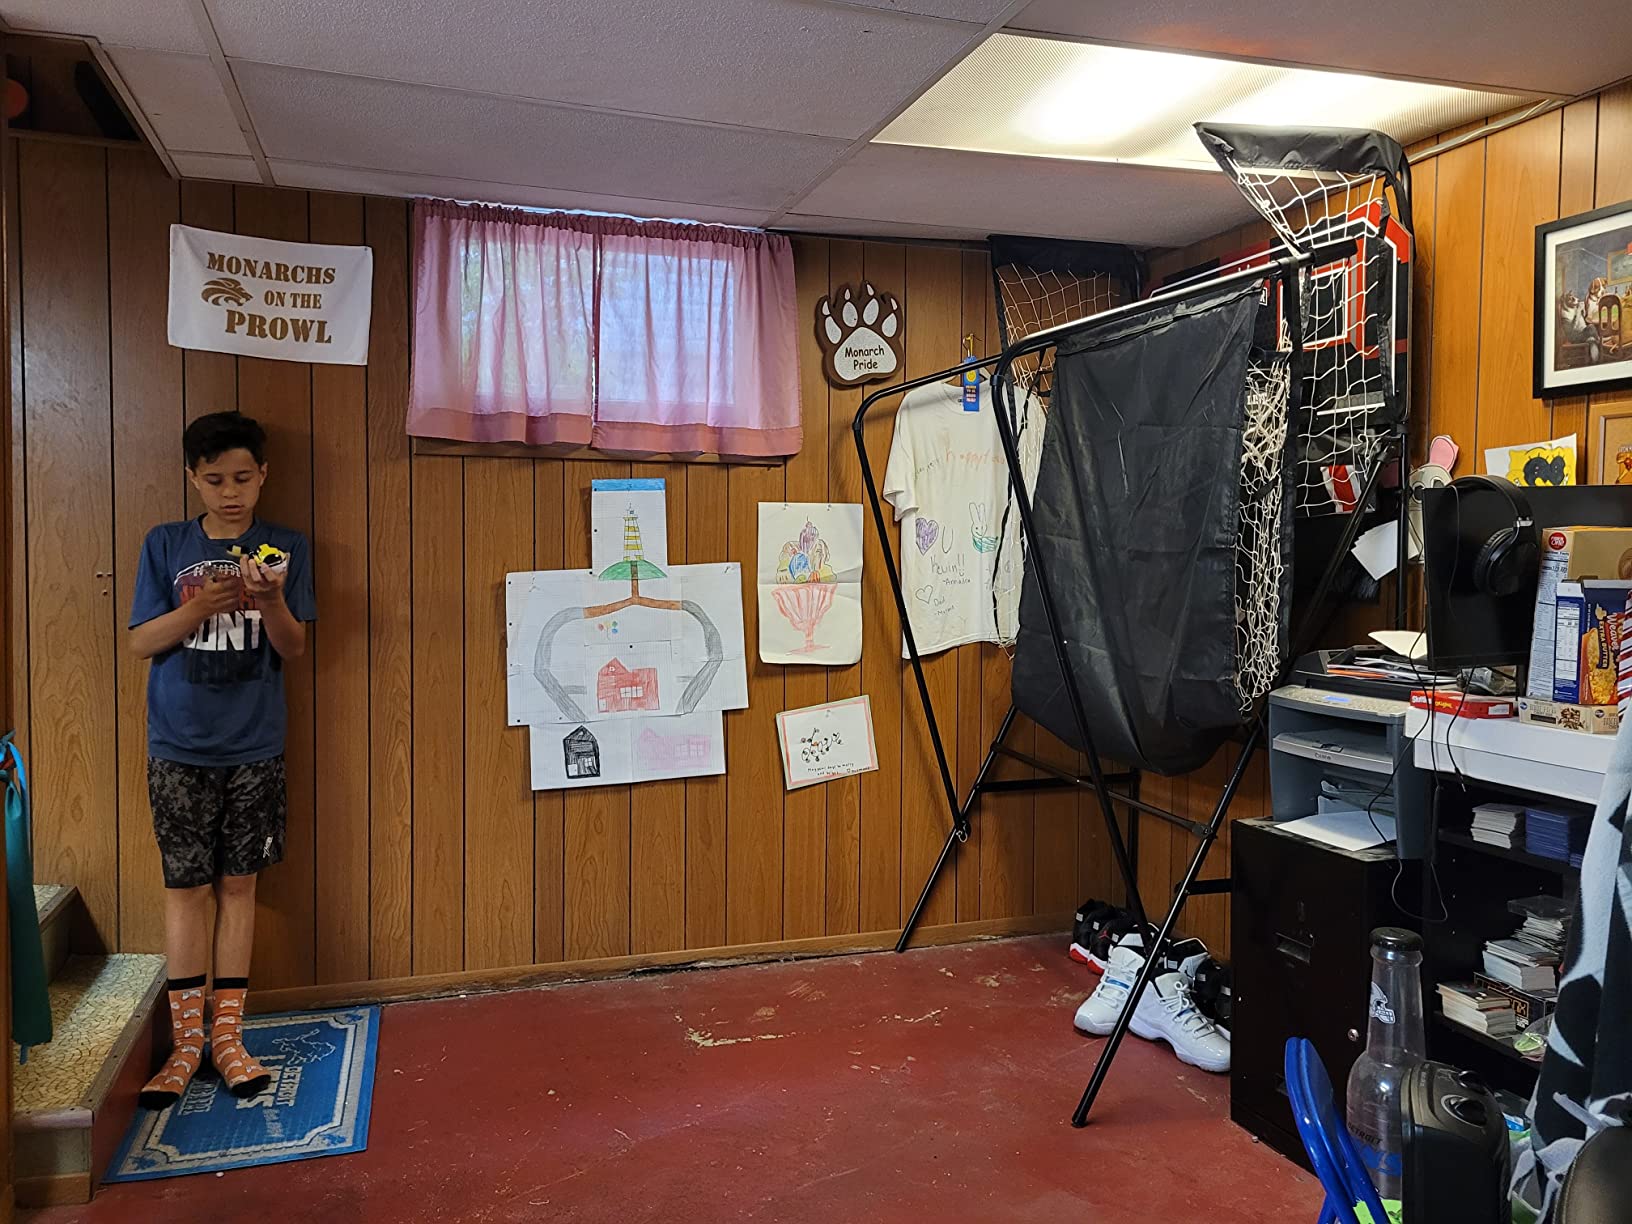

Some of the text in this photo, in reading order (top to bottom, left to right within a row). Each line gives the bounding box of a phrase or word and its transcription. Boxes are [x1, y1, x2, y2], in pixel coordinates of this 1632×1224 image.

[207, 252, 336, 284] MONARCHS
[264, 290, 322, 309] ON THE
[225, 310, 332, 344] PROWL
[844, 345, 885, 358] Monarch
[853, 359, 878, 370] Pride
[1601, 642, 1609, 668] BUTTER
[276, 1066, 303, 1107] DETROIT
